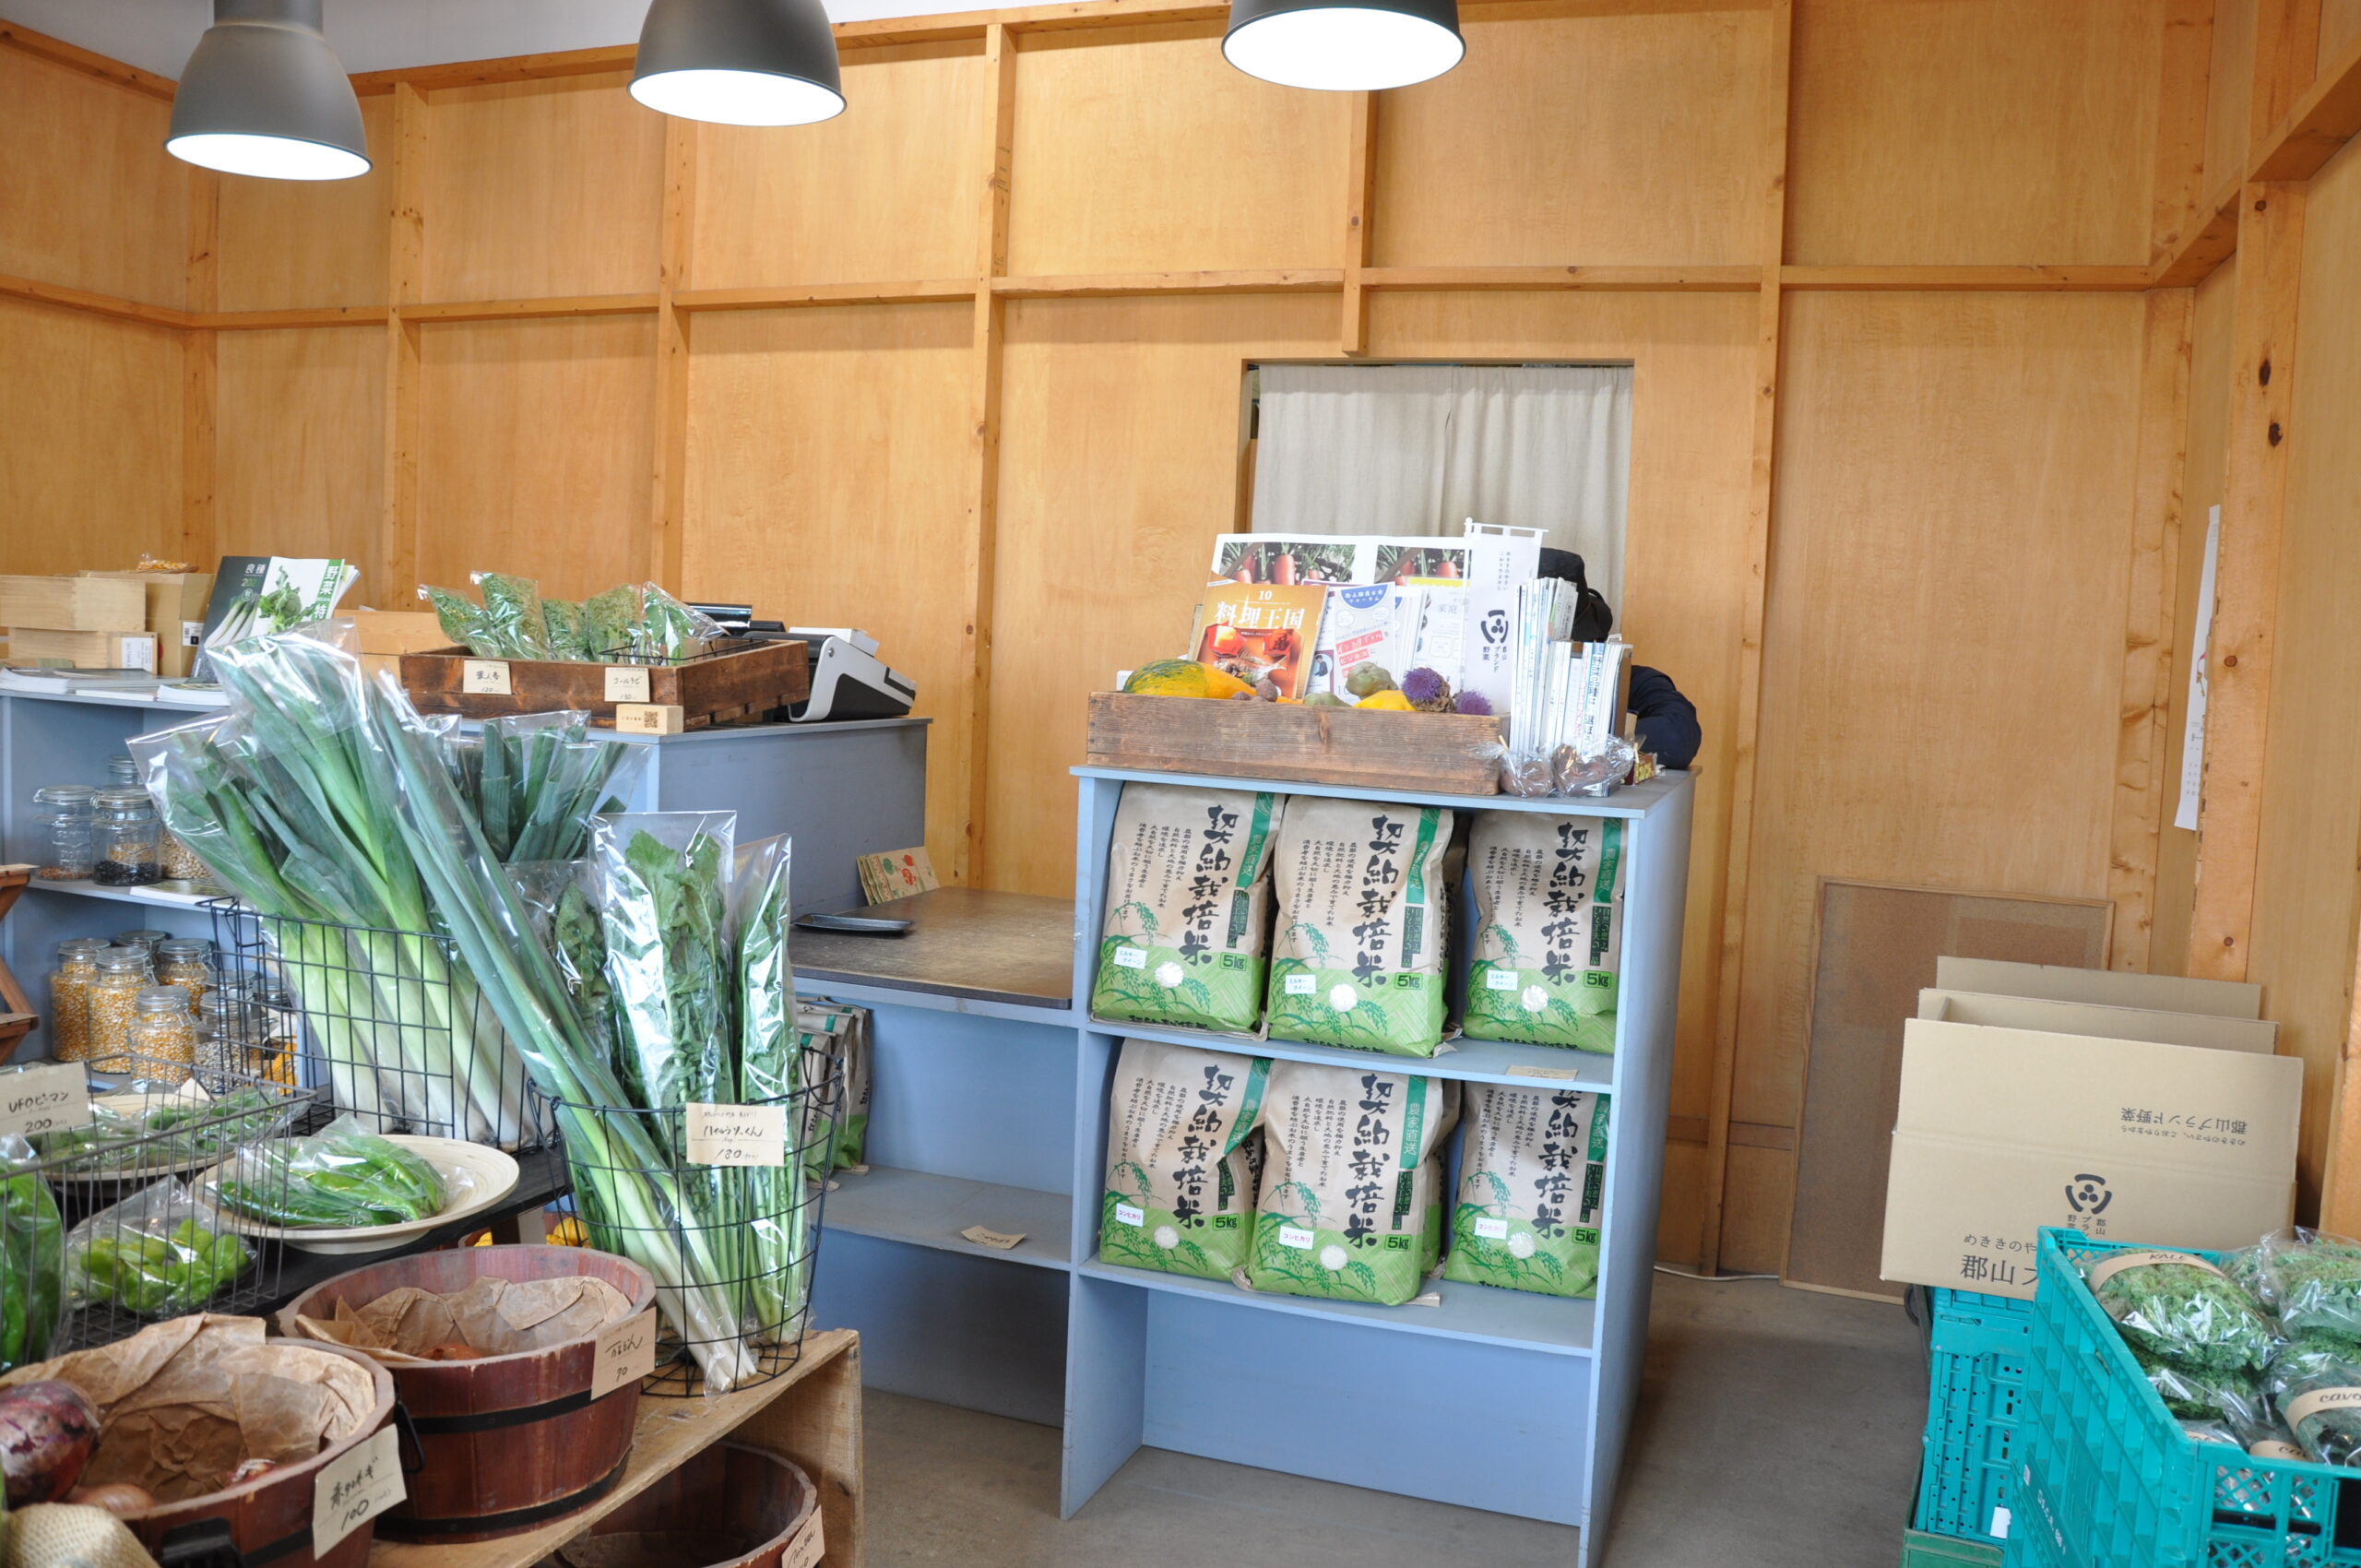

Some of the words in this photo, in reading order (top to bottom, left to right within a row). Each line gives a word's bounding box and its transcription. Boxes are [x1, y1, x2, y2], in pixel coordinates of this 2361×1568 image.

[320, 565, 340, 596] 野菜
[1257, 589, 1273, 600] 10
[1214, 601, 1306, 630] 料理王国
[1179, 804, 1240, 967] 契約栽培米
[1352, 814, 1405, 989] 契約栽培米
[1541, 821, 1589, 986] 契約栽培米
[1223, 956, 1246, 969] 5kg
[1397, 975, 1420, 990] 5kg
[1586, 973, 1609, 988] 5kg
[25, 1118, 53, 1134] 200
[1404, 1101, 1421, 1157] 農家直送
[2119, 1107, 2248, 1135] 郡山ブランド野菜
[715, 1148, 743, 1160] 180
[1173, 1064, 1235, 1229] 契約栽培米
[1344, 1073, 1394, 1249] 契約栽培米
[1215, 1215, 1238, 1229] 5kg
[2095, 1218, 2107, 1236] 郡山
[1386, 1236, 1410, 1251] 5kg
[1574, 1229, 1596, 1244] 5kg
[615, 1365, 629, 1383] 70
[340, 1498, 370, 1532] 100
